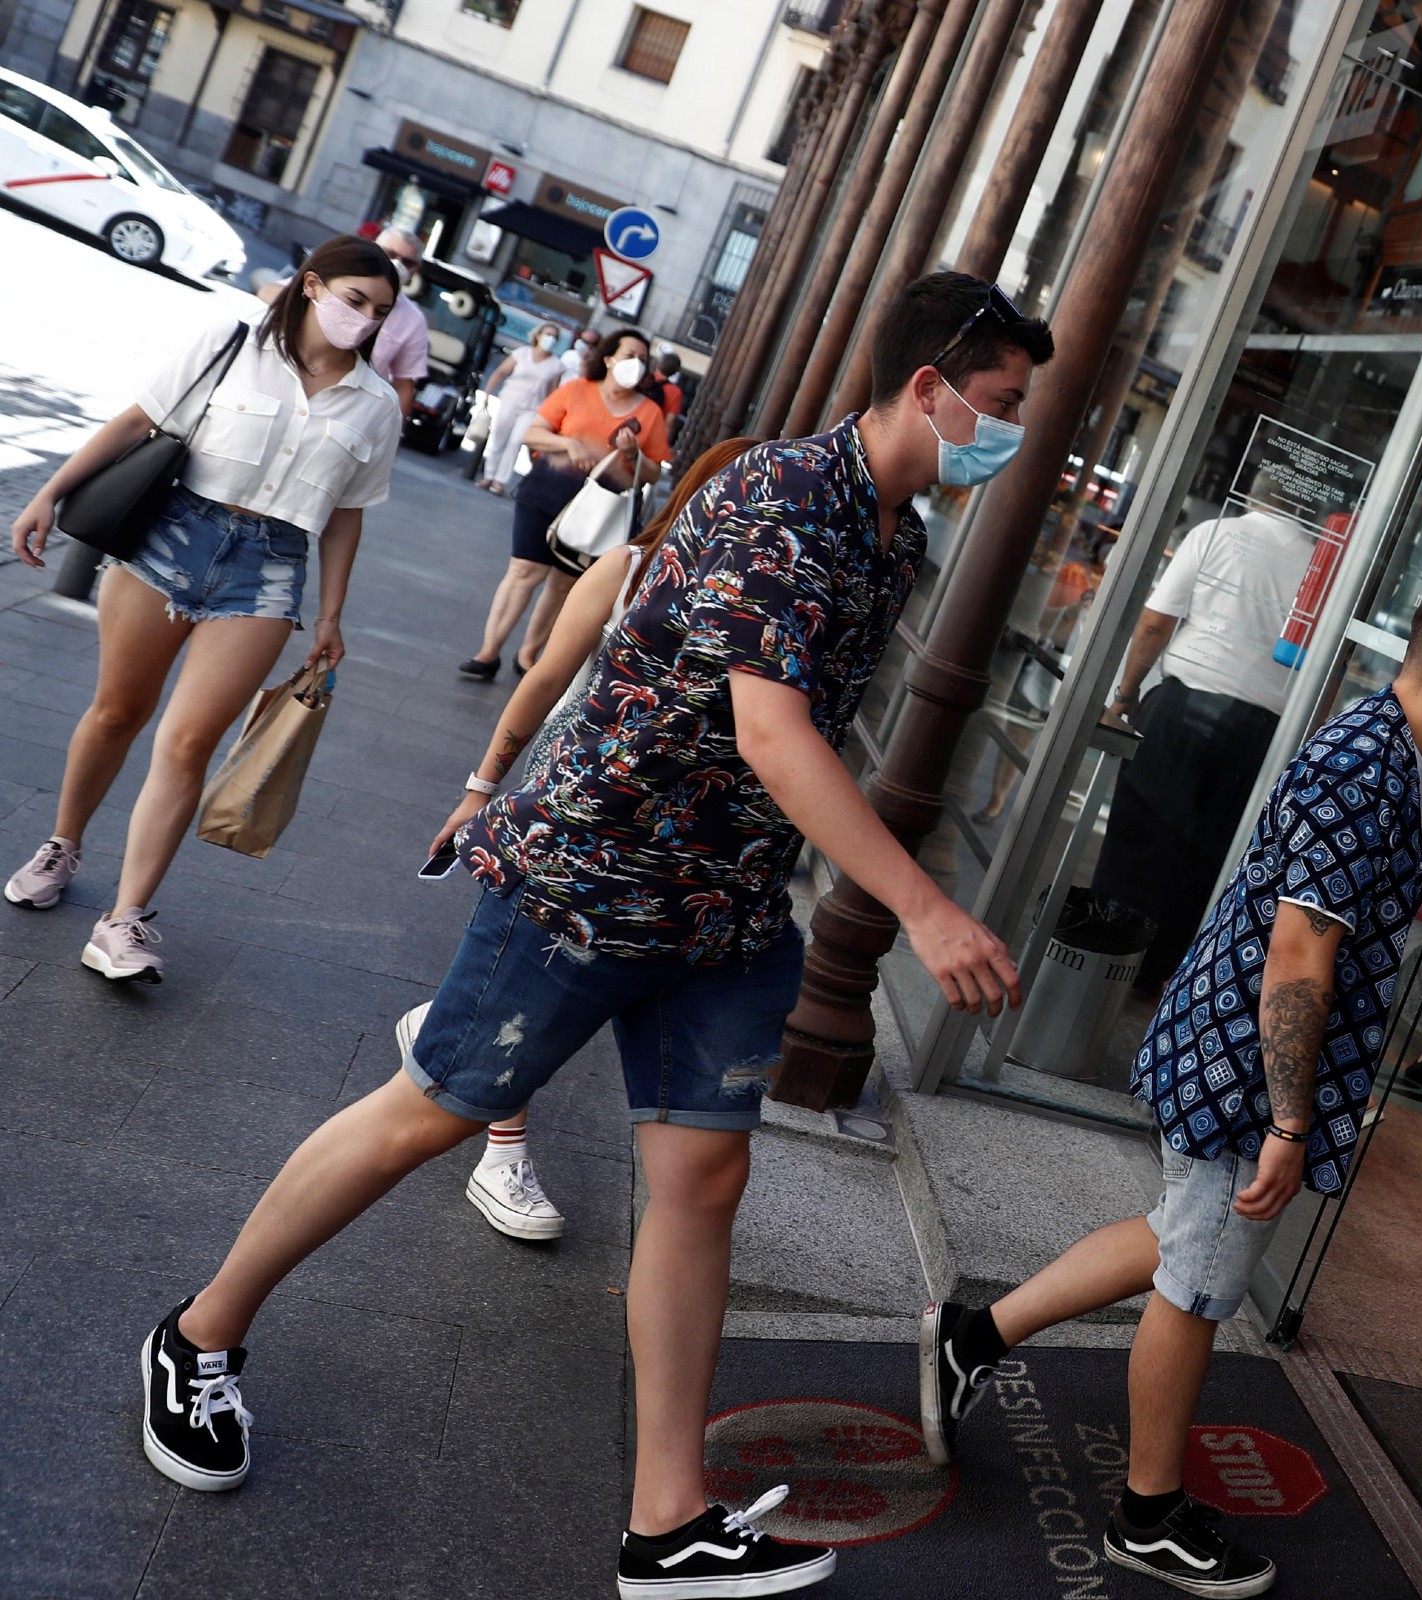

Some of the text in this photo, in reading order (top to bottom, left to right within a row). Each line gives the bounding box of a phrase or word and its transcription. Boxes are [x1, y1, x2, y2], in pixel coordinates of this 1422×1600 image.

[1268, 438, 1292, 452] ENVASES
[1293, 448, 1300, 456] DE
[1301, 452, 1319, 464] VIDRIO
[1328, 463, 1353, 479] EXTERIOR
[1289, 453, 1300, 461] DEL
[1301, 446, 1329, 462] PERMITIDO
[1330, 458, 1348, 470] SACAR
[1295, 461, 1319, 476] GRACIAS
[1261, 457, 1271, 465] WE
[1283, 467, 1295, 476] NOT
[1295, 472, 1322, 488] ALLOWED
[1331, 487, 1345, 497] TAKE
[1279, 477, 1296, 489] GLASS
[1301, 493, 1313, 502] YOU
[1318, 488, 1330, 497] ANY
[1330, 493, 1343, 503] TYPE
[200, 1361, 225, 1371] VANS
[1075, 1422, 1129, 1502] ZON
[1200, 1432, 1285, 1507] STOP
